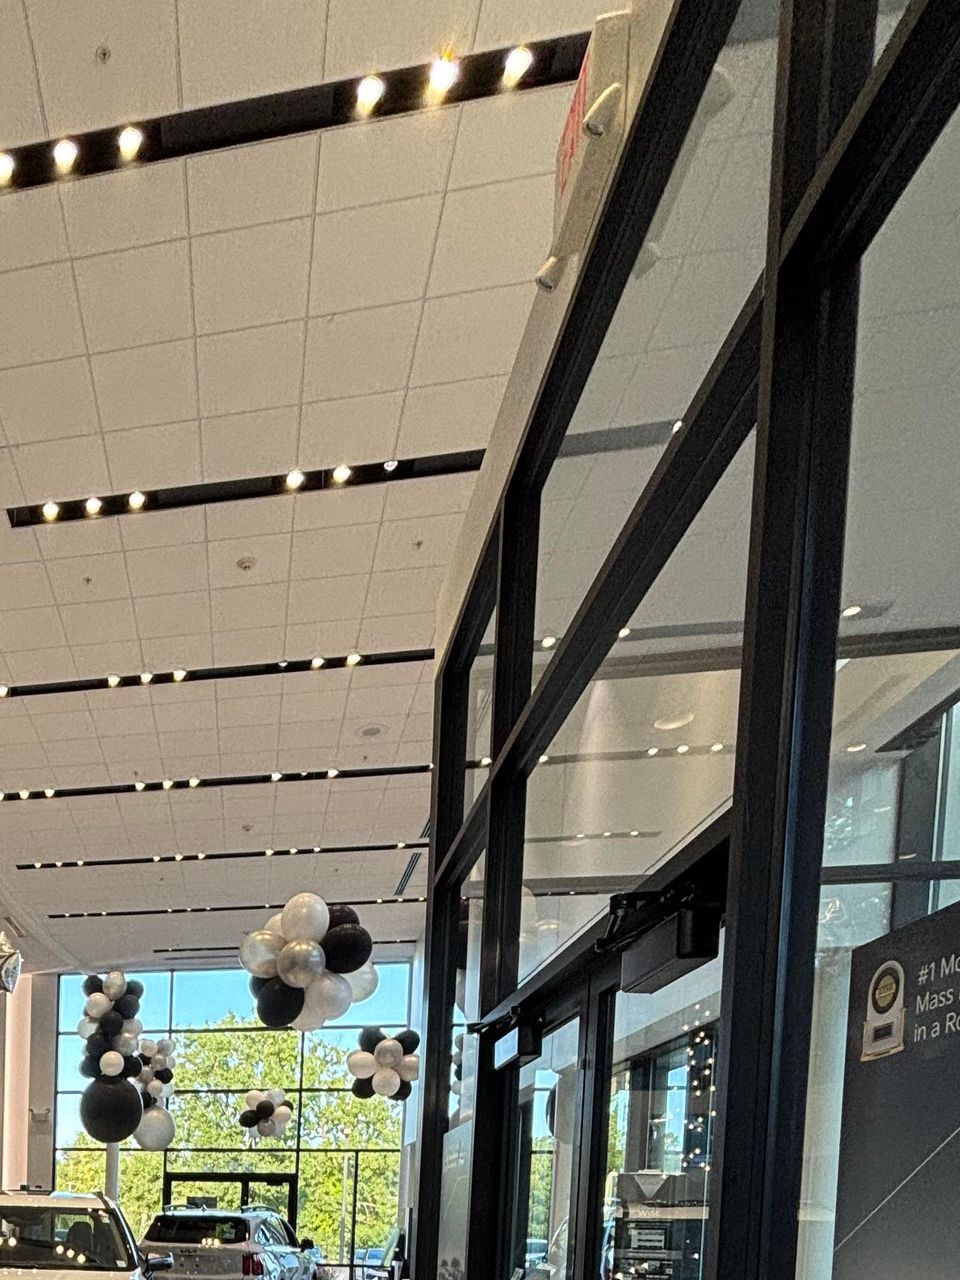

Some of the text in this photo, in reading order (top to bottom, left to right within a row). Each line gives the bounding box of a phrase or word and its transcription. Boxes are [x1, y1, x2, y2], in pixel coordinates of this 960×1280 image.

[918, 961, 935, 985] #1
[916, 988, 954, 1014] Mass
[914, 1024, 926, 1042] in
[931, 1022, 940, 1038] a
